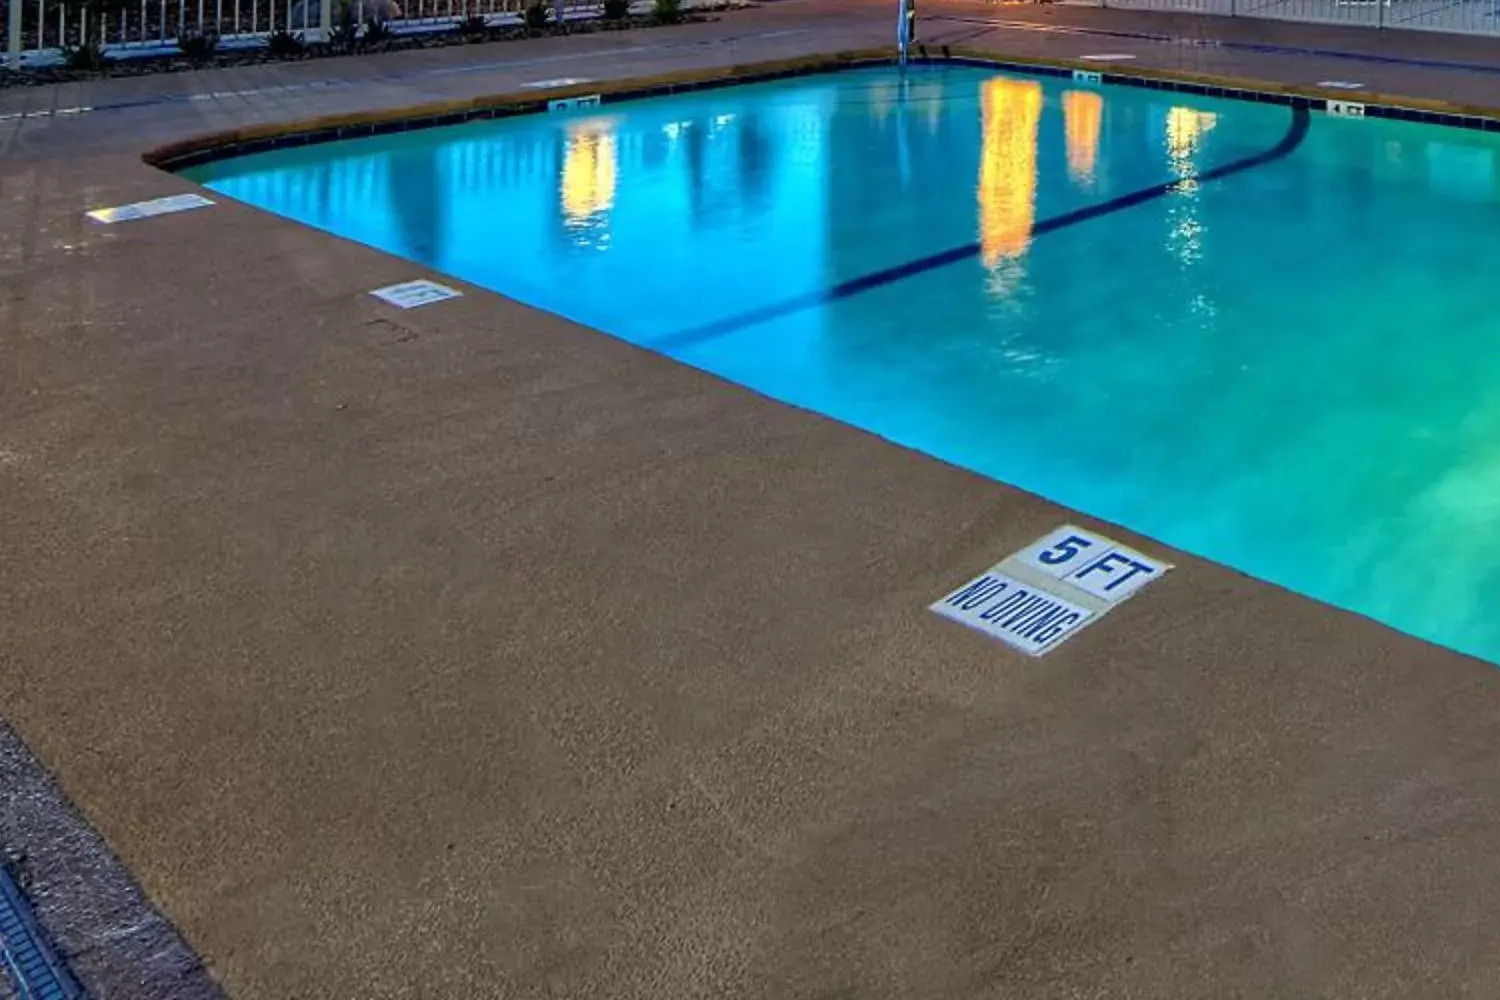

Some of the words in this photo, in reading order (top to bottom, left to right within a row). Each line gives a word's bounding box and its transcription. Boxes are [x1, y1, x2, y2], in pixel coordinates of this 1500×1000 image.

[1038, 535, 1092, 565] 5
[1075, 552, 1154, 591] FT
[946, 575, 1008, 611] NO
[979, 589, 1081, 643] DIVING
